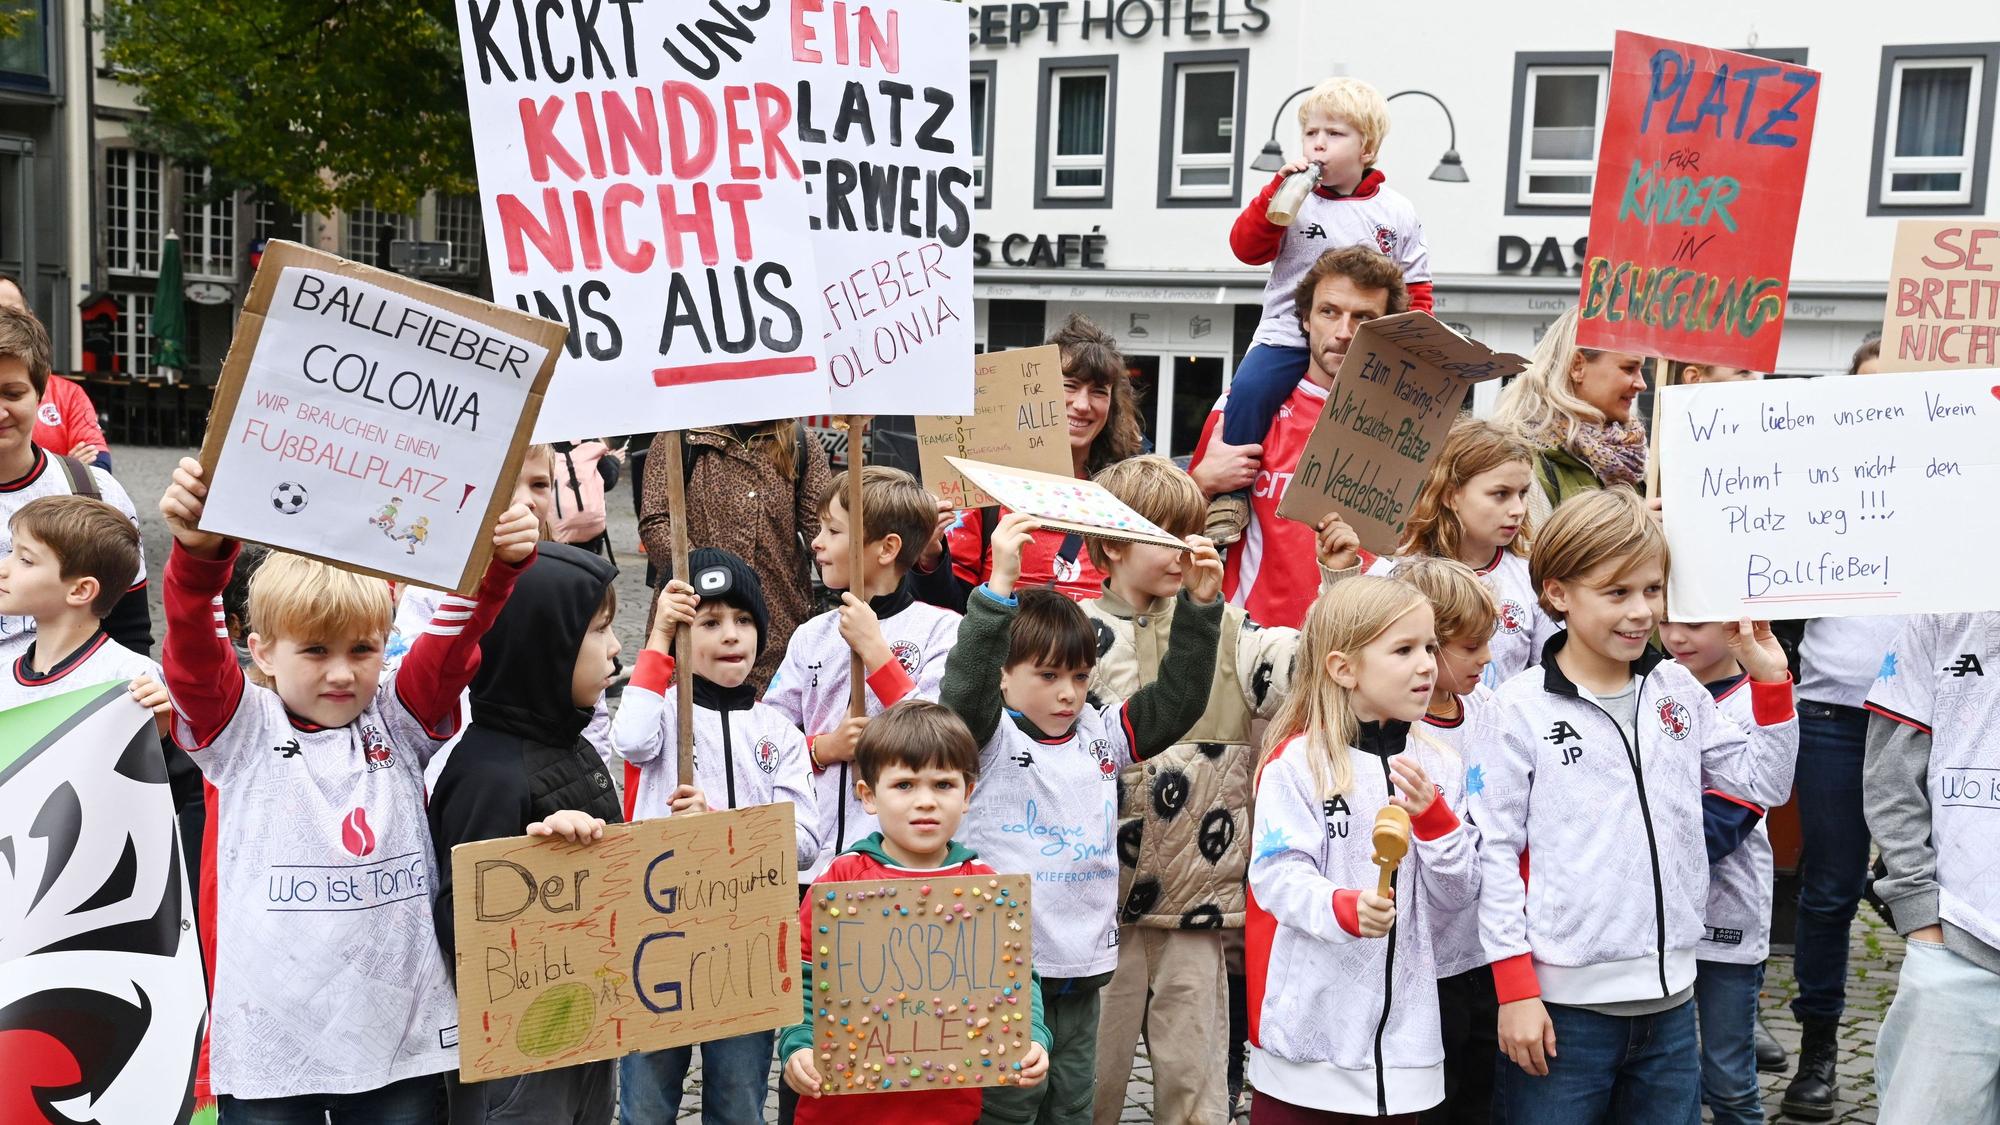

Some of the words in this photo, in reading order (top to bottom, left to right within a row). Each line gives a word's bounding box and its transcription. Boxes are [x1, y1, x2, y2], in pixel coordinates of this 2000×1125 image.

[468, 0, 644, 84] KICKT
[791, 0, 899, 73] EIN
[969, 2, 1068, 44] EPT
[1081, 0, 1270, 40] HOTELS
[1640, 48, 1818, 147] PLATZ
[519, 80, 803, 182] KINDER
[1664, 148, 1700, 172] FÜR
[496, 182, 763, 275] NICHT
[1002, 225, 1106, 268] CAFÉ
[1921, 228, 2000, 271] SE
[659, 261, 803, 356] AUS
[824, 242, 951, 339] FIEBER
[1528, 298, 1566, 310] Lunch
[1581, 257, 1783, 338] BEWEGUNG
[1792, 301, 1837, 315] Burger
[293, 275, 529, 378] BALLFIEBER
[829, 295, 960, 392] OLONIA
[1898, 324, 2000, 365] NICH
[303, 344, 480, 431] COLONIA
[1021, 362, 1041, 377] IST
[257, 390, 290, 414] WIR
[296, 404, 388, 445] BRAUCHEN
[395, 434, 441, 460] EINEN
[1018, 400, 1059, 431] ALLE
[1328, 382, 1358, 424] Wir
[1688, 408, 1739, 442] Wir
[1834, 405, 1905, 426] unseren
[1925, 391, 1977, 422] Verein
[1029, 436, 1045, 449] DA
[1702, 463, 1782, 498] Nehmt
[1808, 466, 1840, 485] uns
[1854, 456, 1896, 479] nicht
[1926, 457, 1961, 478] den
[1721, 505, 1786, 534] Platz
[1808, 508, 1847, 535] weg
[1561, 746, 1584, 766] JP
[1942, 776, 1981, 799] Wo
[1001, 799, 1084, 857] cologne
[1327, 821, 1349, 839] BU
[269, 876, 317, 902] Wo
[326, 876, 363, 902] ist
[475, 859, 590, 922] Der
[486, 944, 575, 1004] Bleibt
[837, 911, 1000, 993] FUSSBALL
[864, 1018, 963, 1060] ALLE
